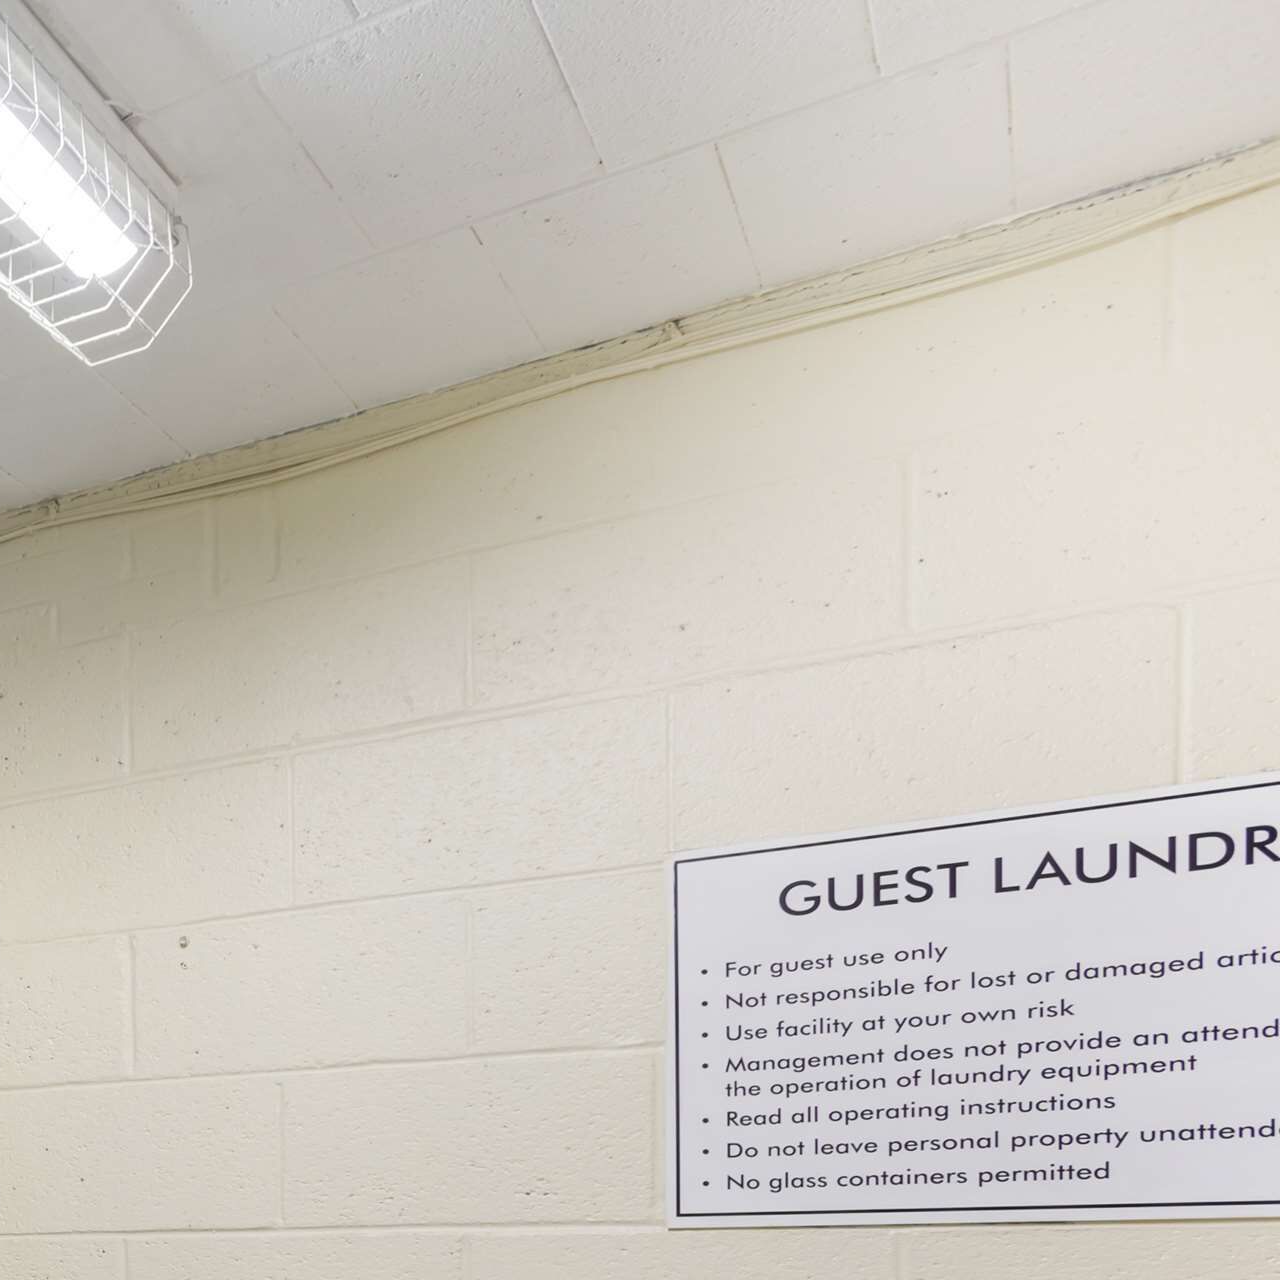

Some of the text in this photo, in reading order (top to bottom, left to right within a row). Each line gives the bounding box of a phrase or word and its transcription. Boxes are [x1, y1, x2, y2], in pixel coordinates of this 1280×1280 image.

[778, 824, 1280, 916] GUEST LAUNDR
[725, 941, 948, 978] For guest use only
[726, 992, 767, 1009] Not
[776, 978, 915, 1007] responsible
[924, 974, 961, 993] for
[971, 970, 1017, 989] lost
[1026, 970, 1055, 985] or
[1065, 951, 1204, 981] damaged
[726, 998, 1075, 1041] Use facility at your own risk
[725, 1018, 1279, 1073] Management does not provide an attend
[725, 1055, 1197, 1098] the operation of laundry equipment
[726, 1093, 1116, 1127] Read all operating instructions
[727, 1118, 1280, 1159] Do not leave personal property unattend
[727, 1160, 1110, 1194] No glass containers permitted
